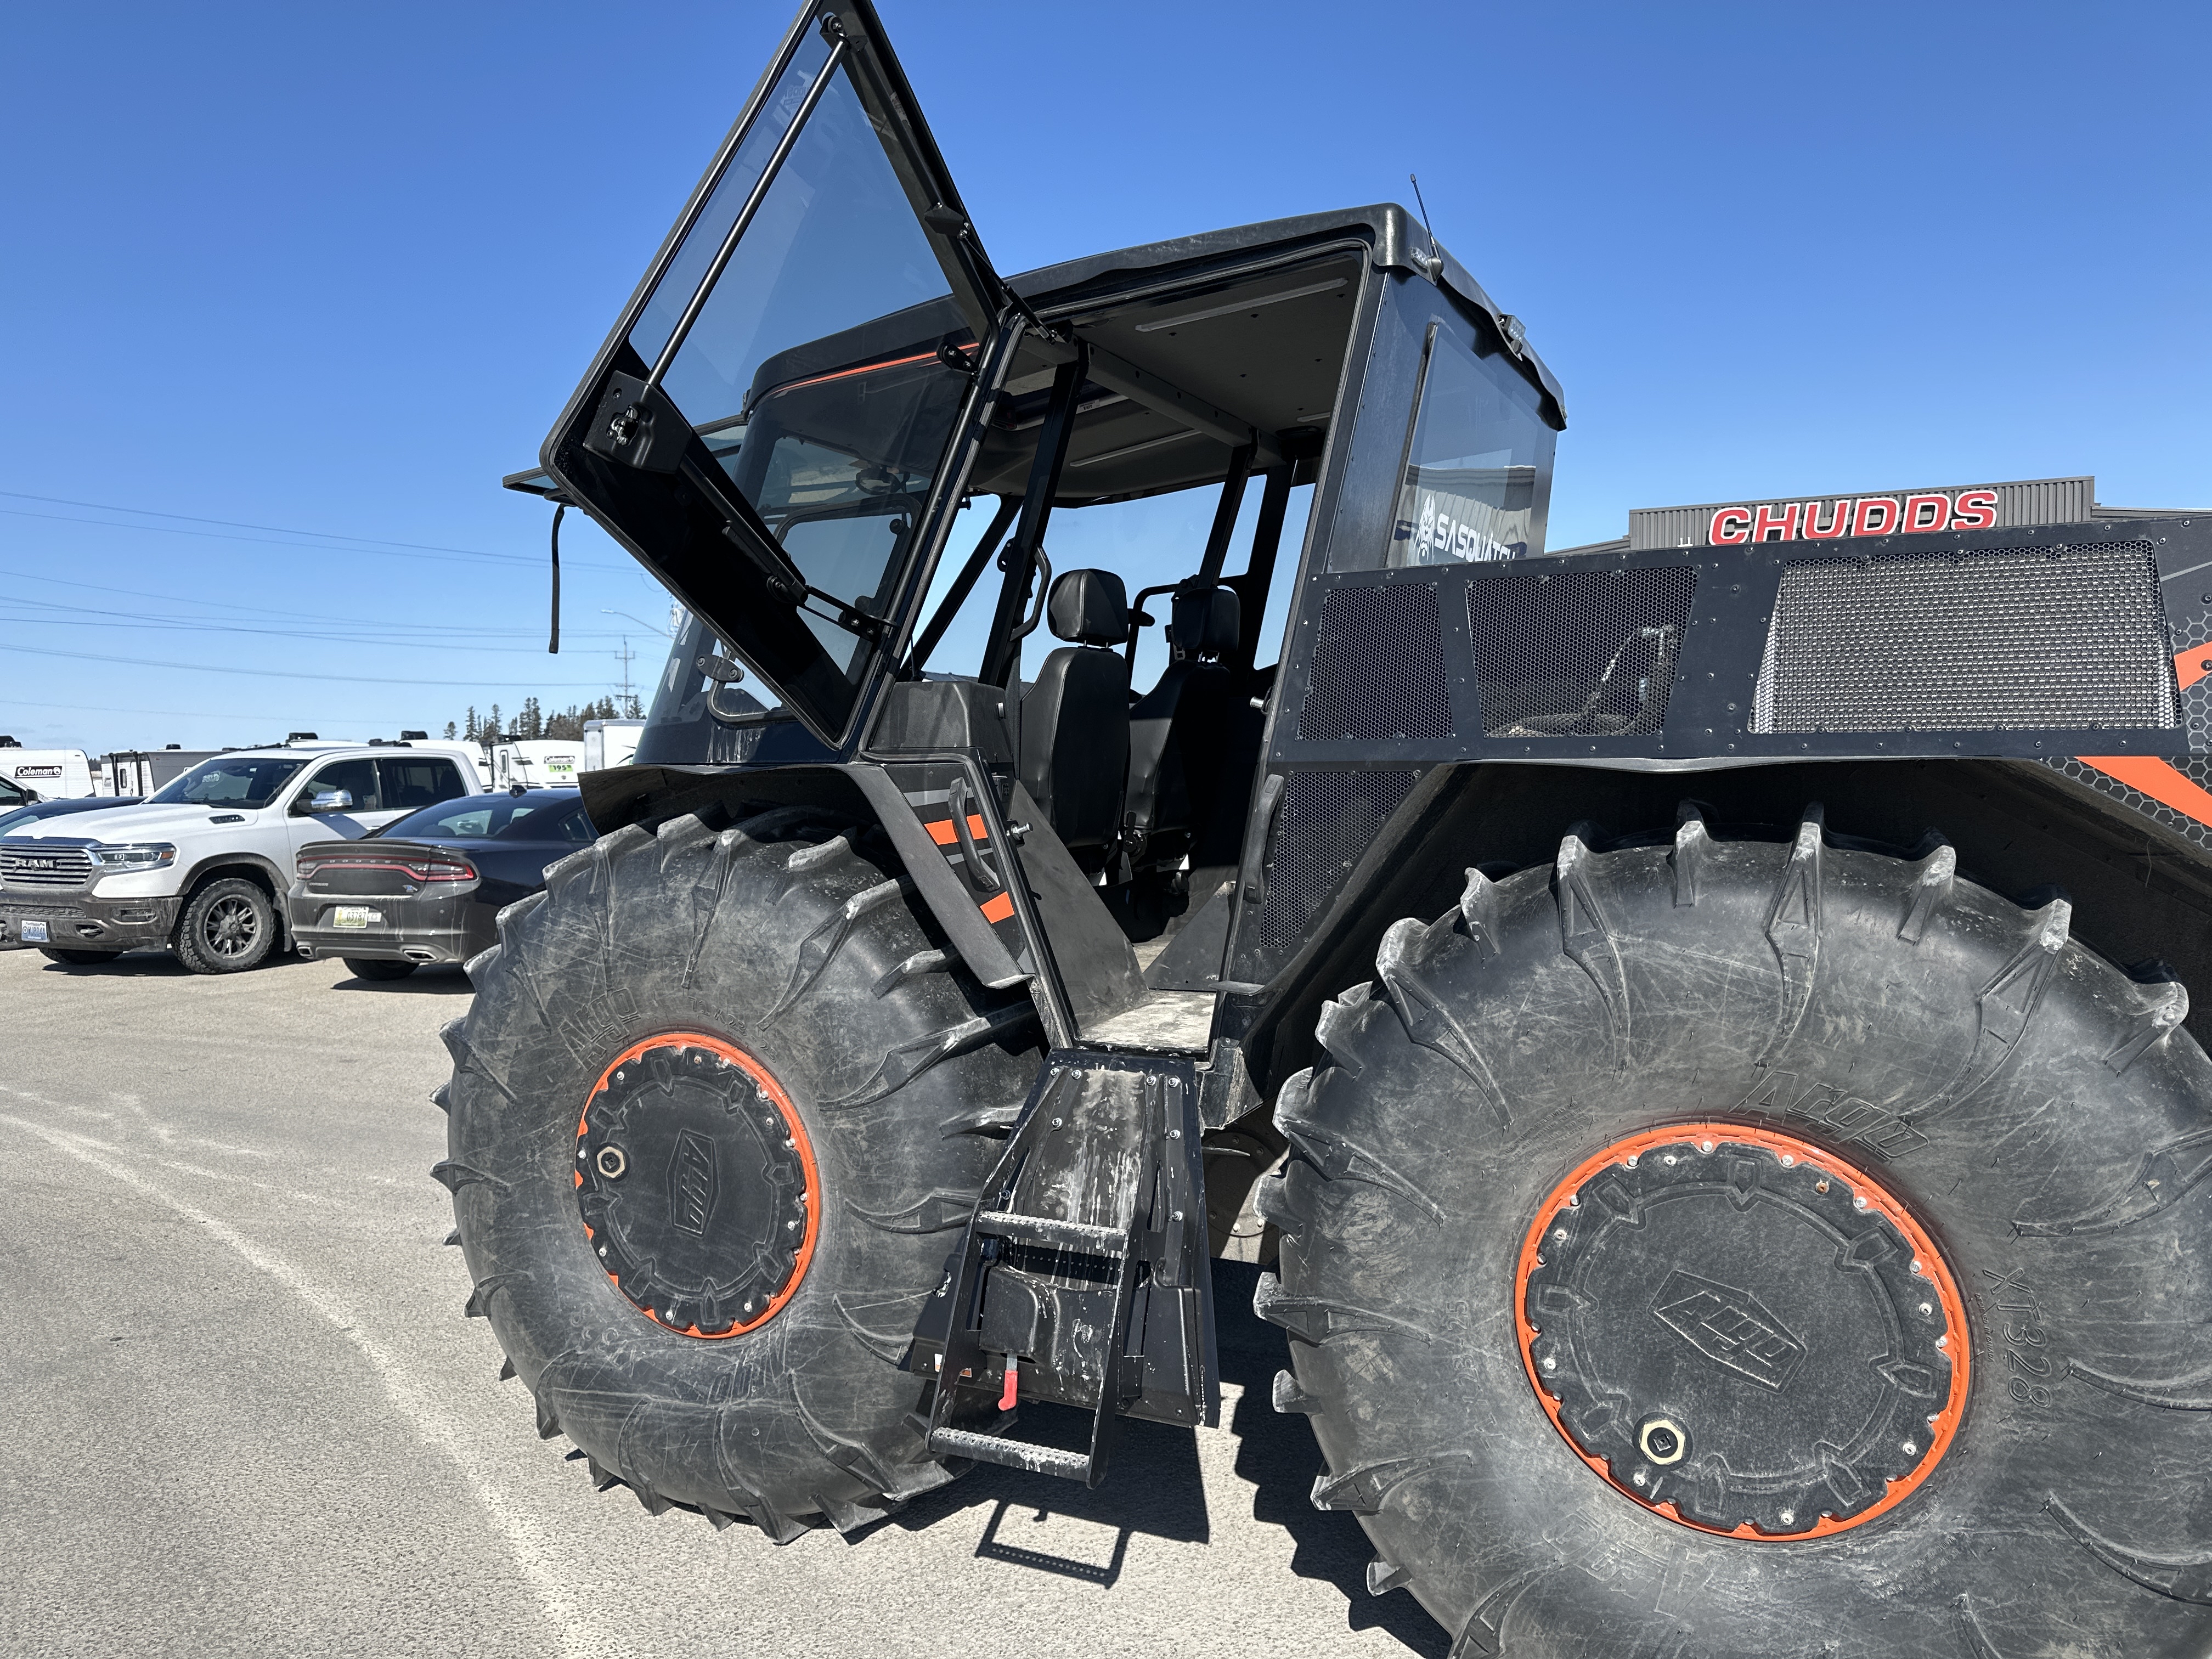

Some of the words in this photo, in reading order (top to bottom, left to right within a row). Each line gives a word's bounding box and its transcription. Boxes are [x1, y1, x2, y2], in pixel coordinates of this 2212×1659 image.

[1708, 490, 1998, 545] CHUDDS
[18, 766, 53, 776] Coleman
[15, 858, 54, 868] RAM
[727, 1013, 747, 1036] 23
